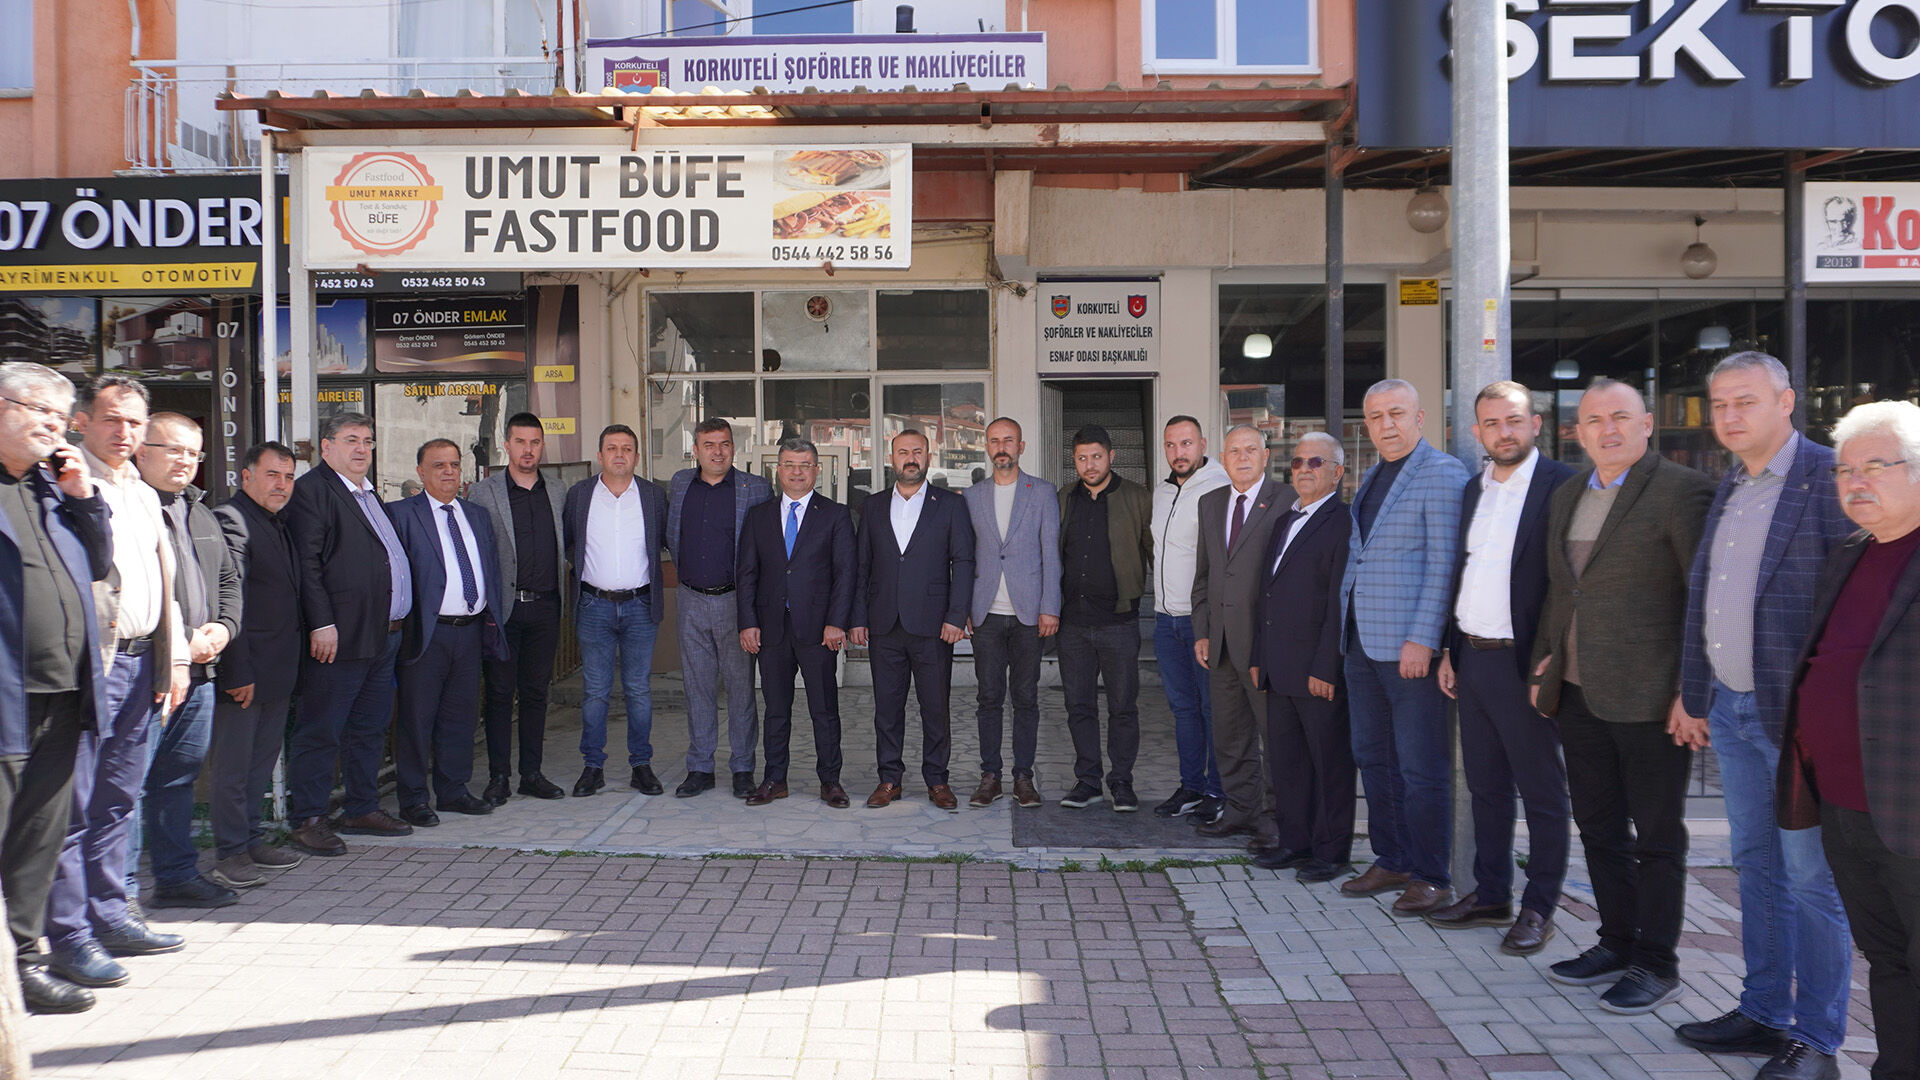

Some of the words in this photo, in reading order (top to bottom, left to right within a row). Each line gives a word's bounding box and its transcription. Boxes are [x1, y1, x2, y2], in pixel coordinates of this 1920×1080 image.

[614, 62, 658, 70] KORKUTELİ
[684, 53, 777, 82] KORKUTELİ
[785, 52, 872, 84] ŞOFÖRLER
[879, 56, 899, 78] VE
[906, 50, 1026, 78] NAKLİYECİLER
[364, 172, 405, 182] Fastfood
[466, 156, 600, 199] UMUT
[620, 150, 745, 198] BÜFE
[349, 189, 376, 198] UMUT
[380, 189, 419, 198] MARKET
[0, 201, 50, 250] 07
[61, 188, 262, 249] ÖNDER
[368, 211, 399, 224] BÜFE
[465, 209, 719, 253] FASTFOOD
[772, 246, 811, 261] 0544
[816, 245, 844, 261] 442
[850, 245, 869, 261] 58
[874, 245, 893, 260] 56
[1823, 258, 1853, 268] 2013
[142, 266, 242, 283] OTOMOTİV
[401, 277, 429, 287] 0532
[432, 277, 452, 287] 452
[455, 277, 469, 287] 50
[472, 276, 486, 286] 43
[320, 279, 342, 289] 452
[344, 278, 358, 288] 50
[360, 278, 374, 288] 43
[1077, 301, 1120, 315] KORKUTELİ
[393, 312, 409, 325] 07
[413, 309, 460, 324] ÖNDER
[464, 309, 507, 322] EMLAK
[217, 322, 239, 338] 07
[1044, 324, 1084, 341] ŞOFÖRLER
[1086, 327, 1096, 338] VE
[1098, 324, 1153, 338] NAKLİYECİLER
[1049, 351, 1074, 362] ESNAF
[1077, 350, 1100, 362] ODASI
[1102, 347, 1148, 364] BAŞKANLIĞI
[545, 369, 563, 378] ARSA
[317, 388, 362, 402] AİRELER
[404, 384, 446, 397] SATILIK
[448, 383, 497, 396] ARSALAR
[221, 367, 238, 487] ÖNDER
[544, 422, 566, 431] TARLA
